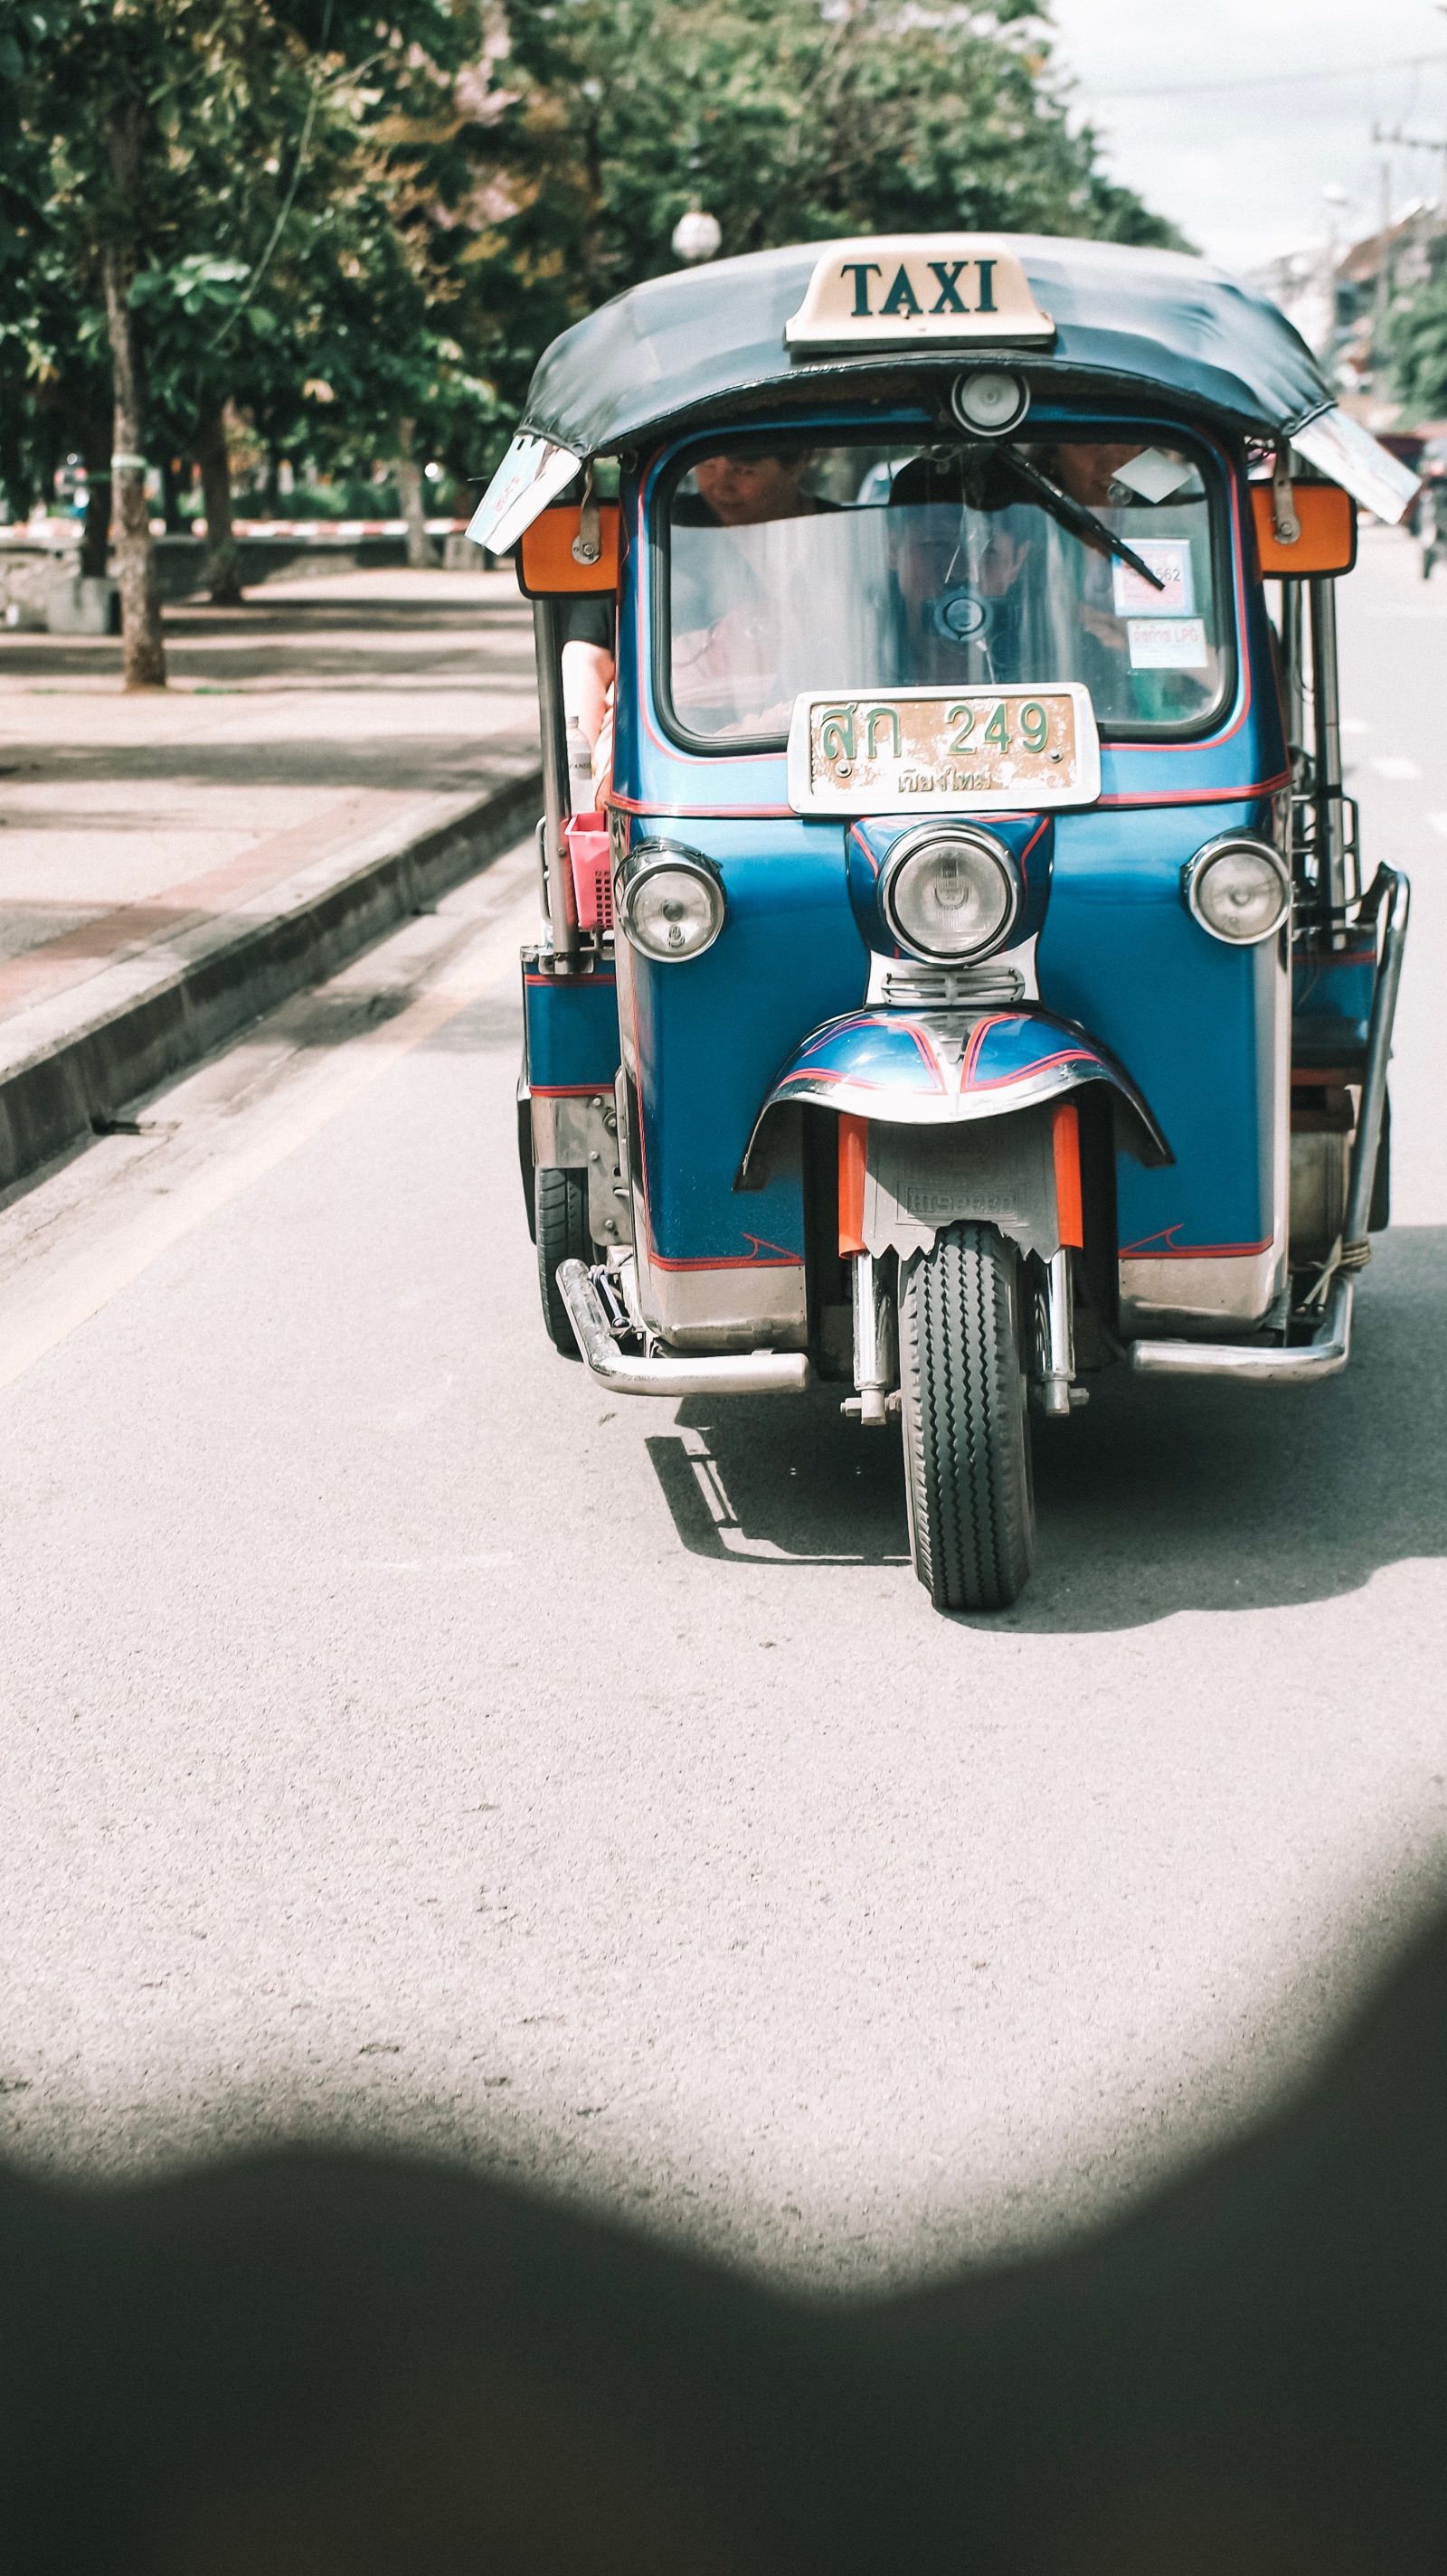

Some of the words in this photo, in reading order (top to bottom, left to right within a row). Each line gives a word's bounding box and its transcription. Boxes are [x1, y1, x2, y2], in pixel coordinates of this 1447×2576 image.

[839, 259, 998, 316] TAXI
[1149, 567, 1181, 582] 562
[820, 701, 903, 760] สก
[946, 702, 1050, 757] 249
